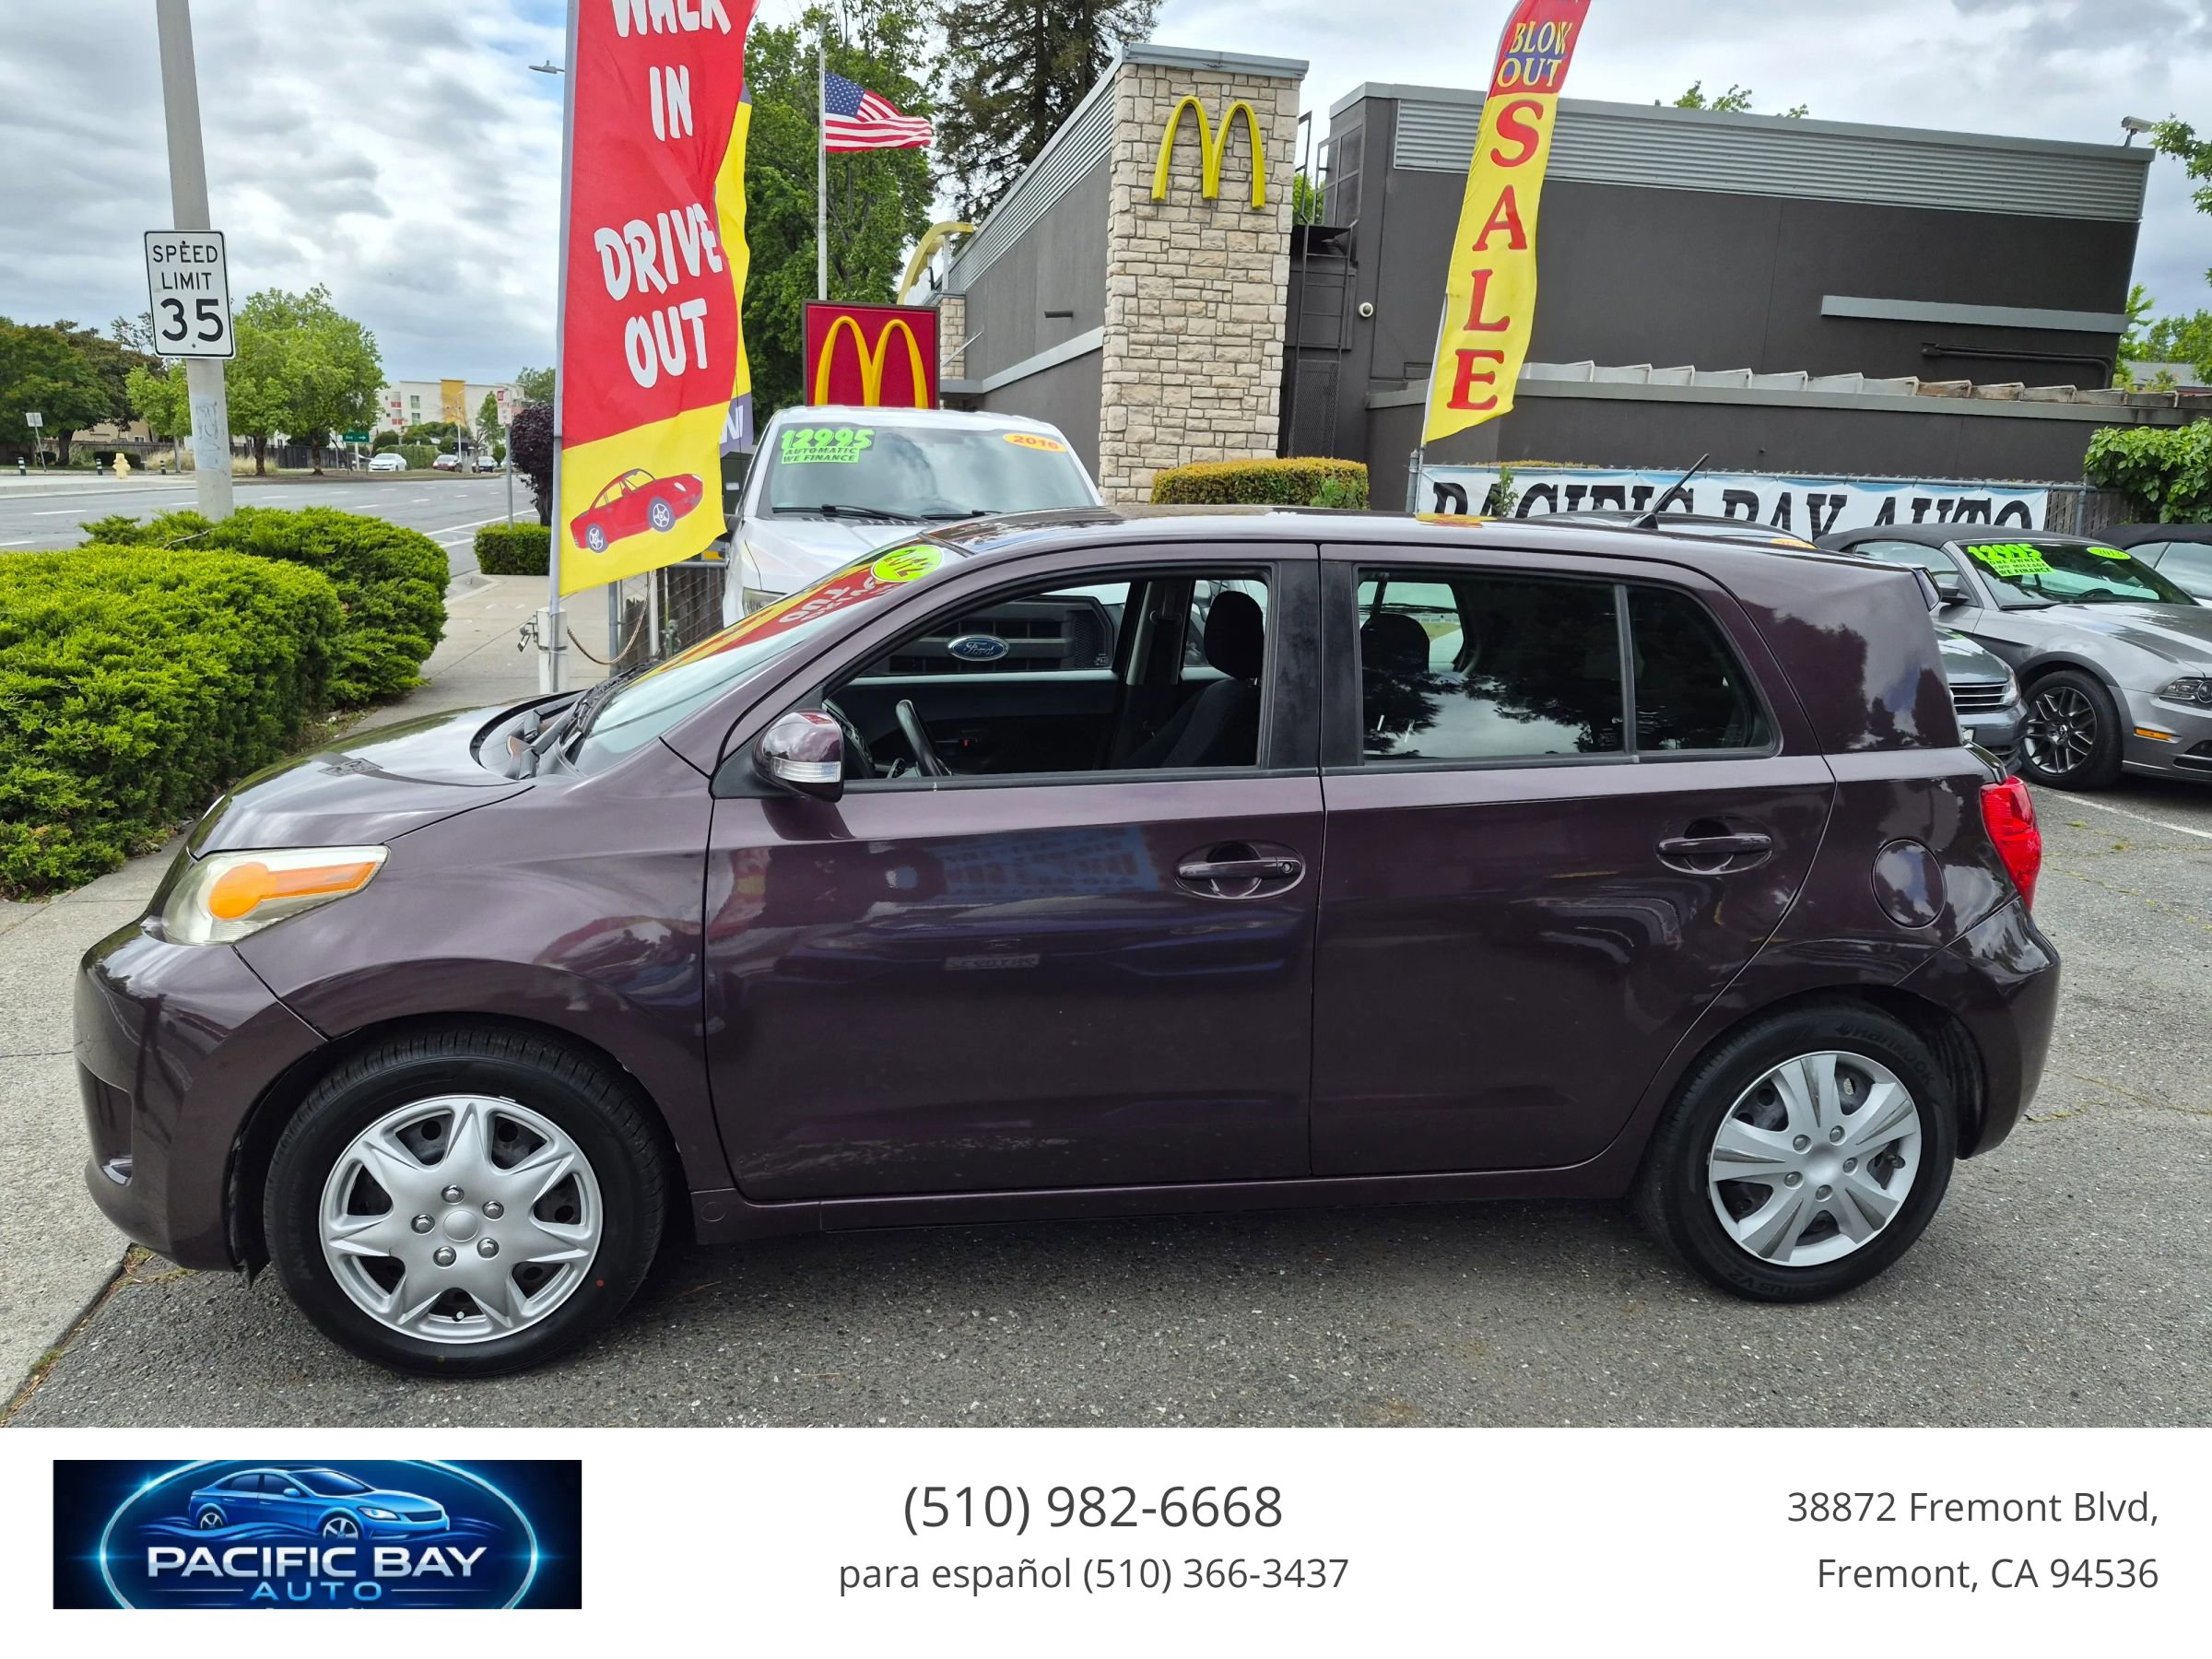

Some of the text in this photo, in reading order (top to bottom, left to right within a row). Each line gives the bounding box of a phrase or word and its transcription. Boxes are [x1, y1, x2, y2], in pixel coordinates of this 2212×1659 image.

[1509, 21, 1572, 55] BLOW
[1497, 58, 1561, 88] OUT
[649, 65, 693, 142] IN
[153, 244, 218, 263] SPEED
[594, 203, 723, 301] DRIVE
[1446, 99, 1545, 411] SALE
[161, 272, 212, 290] LIMIT
[160, 298, 224, 342] 35
[625, 298, 708, 388] OUT
[781, 428, 876, 450] 12995
[785, 447, 858, 455] AUTOMATIC
[1967, 543, 2042, 561] 12995
